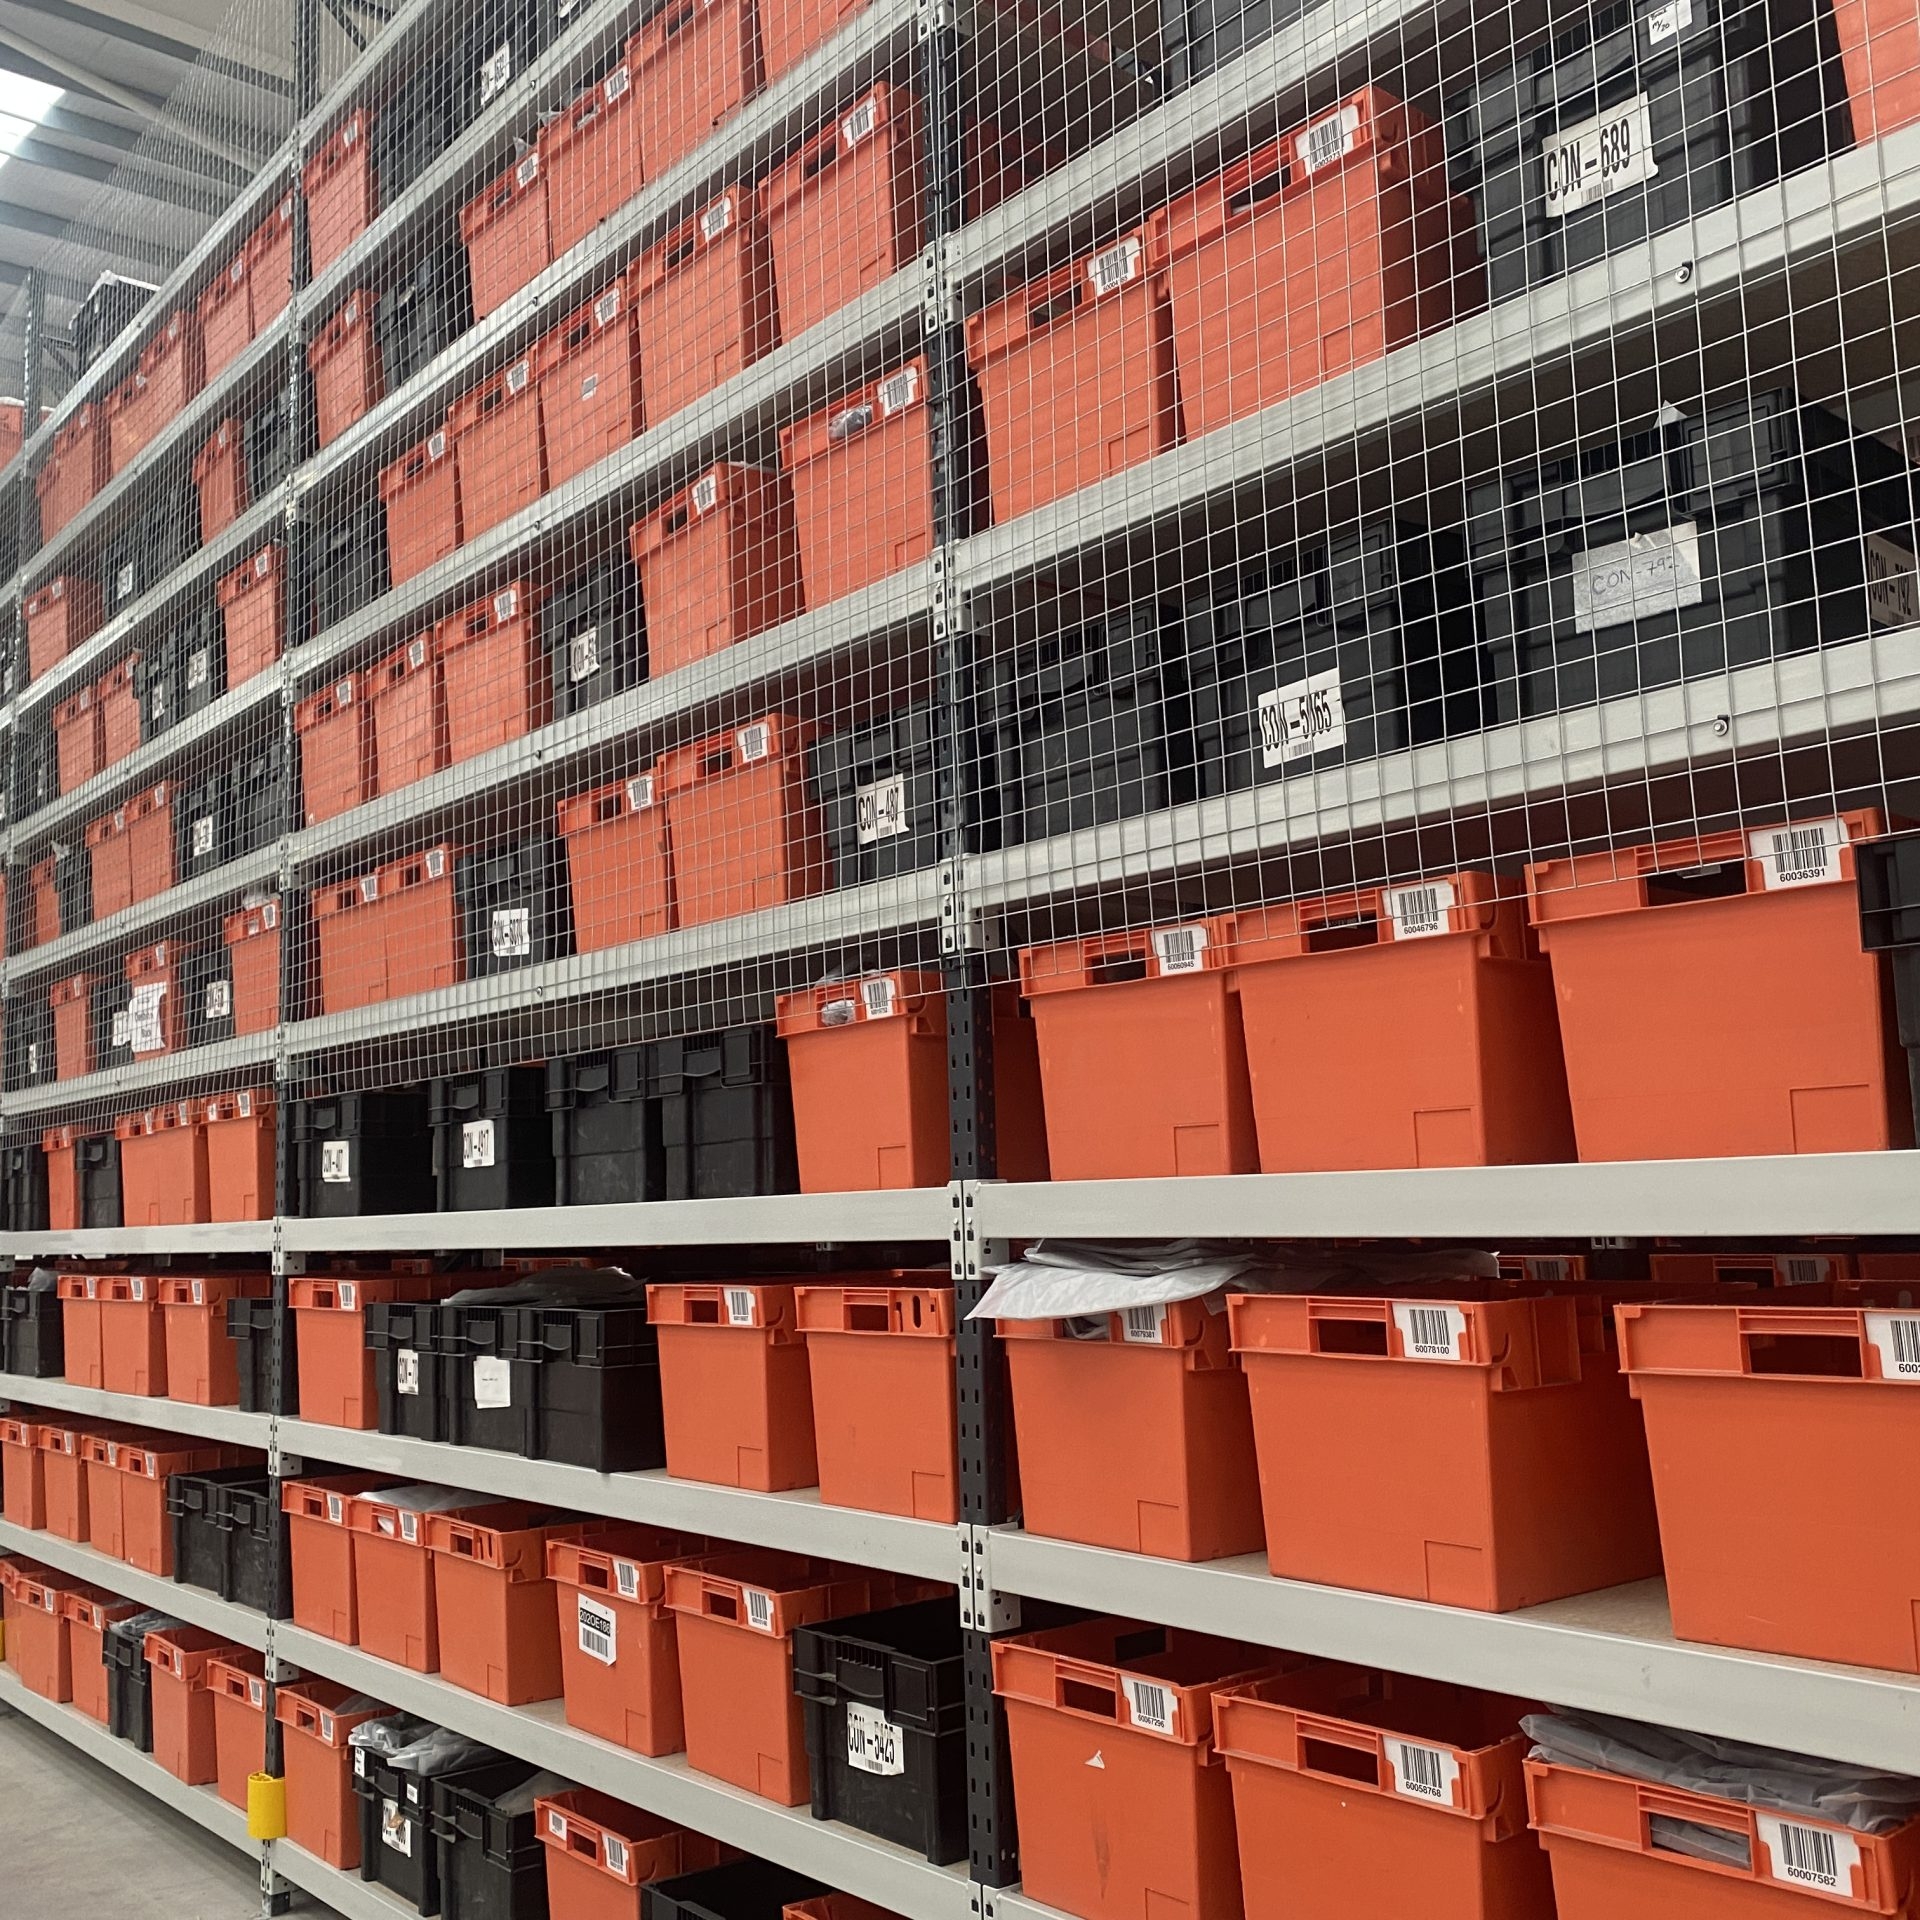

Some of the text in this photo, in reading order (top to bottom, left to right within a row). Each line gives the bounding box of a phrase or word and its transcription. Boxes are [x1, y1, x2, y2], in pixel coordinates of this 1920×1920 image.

[1547, 118, 1630, 201] CON-689
[1780, 867, 1825, 882] 60036391
[1403, 922, 1438, 935] 60046796
[1415, 1345, 1450, 1355] 60078100
[848, 1712, 895, 1765] CON-5425
[1405, 1781, 1442, 1798] 60058768
[1787, 1866, 1837, 1887] 60007582
